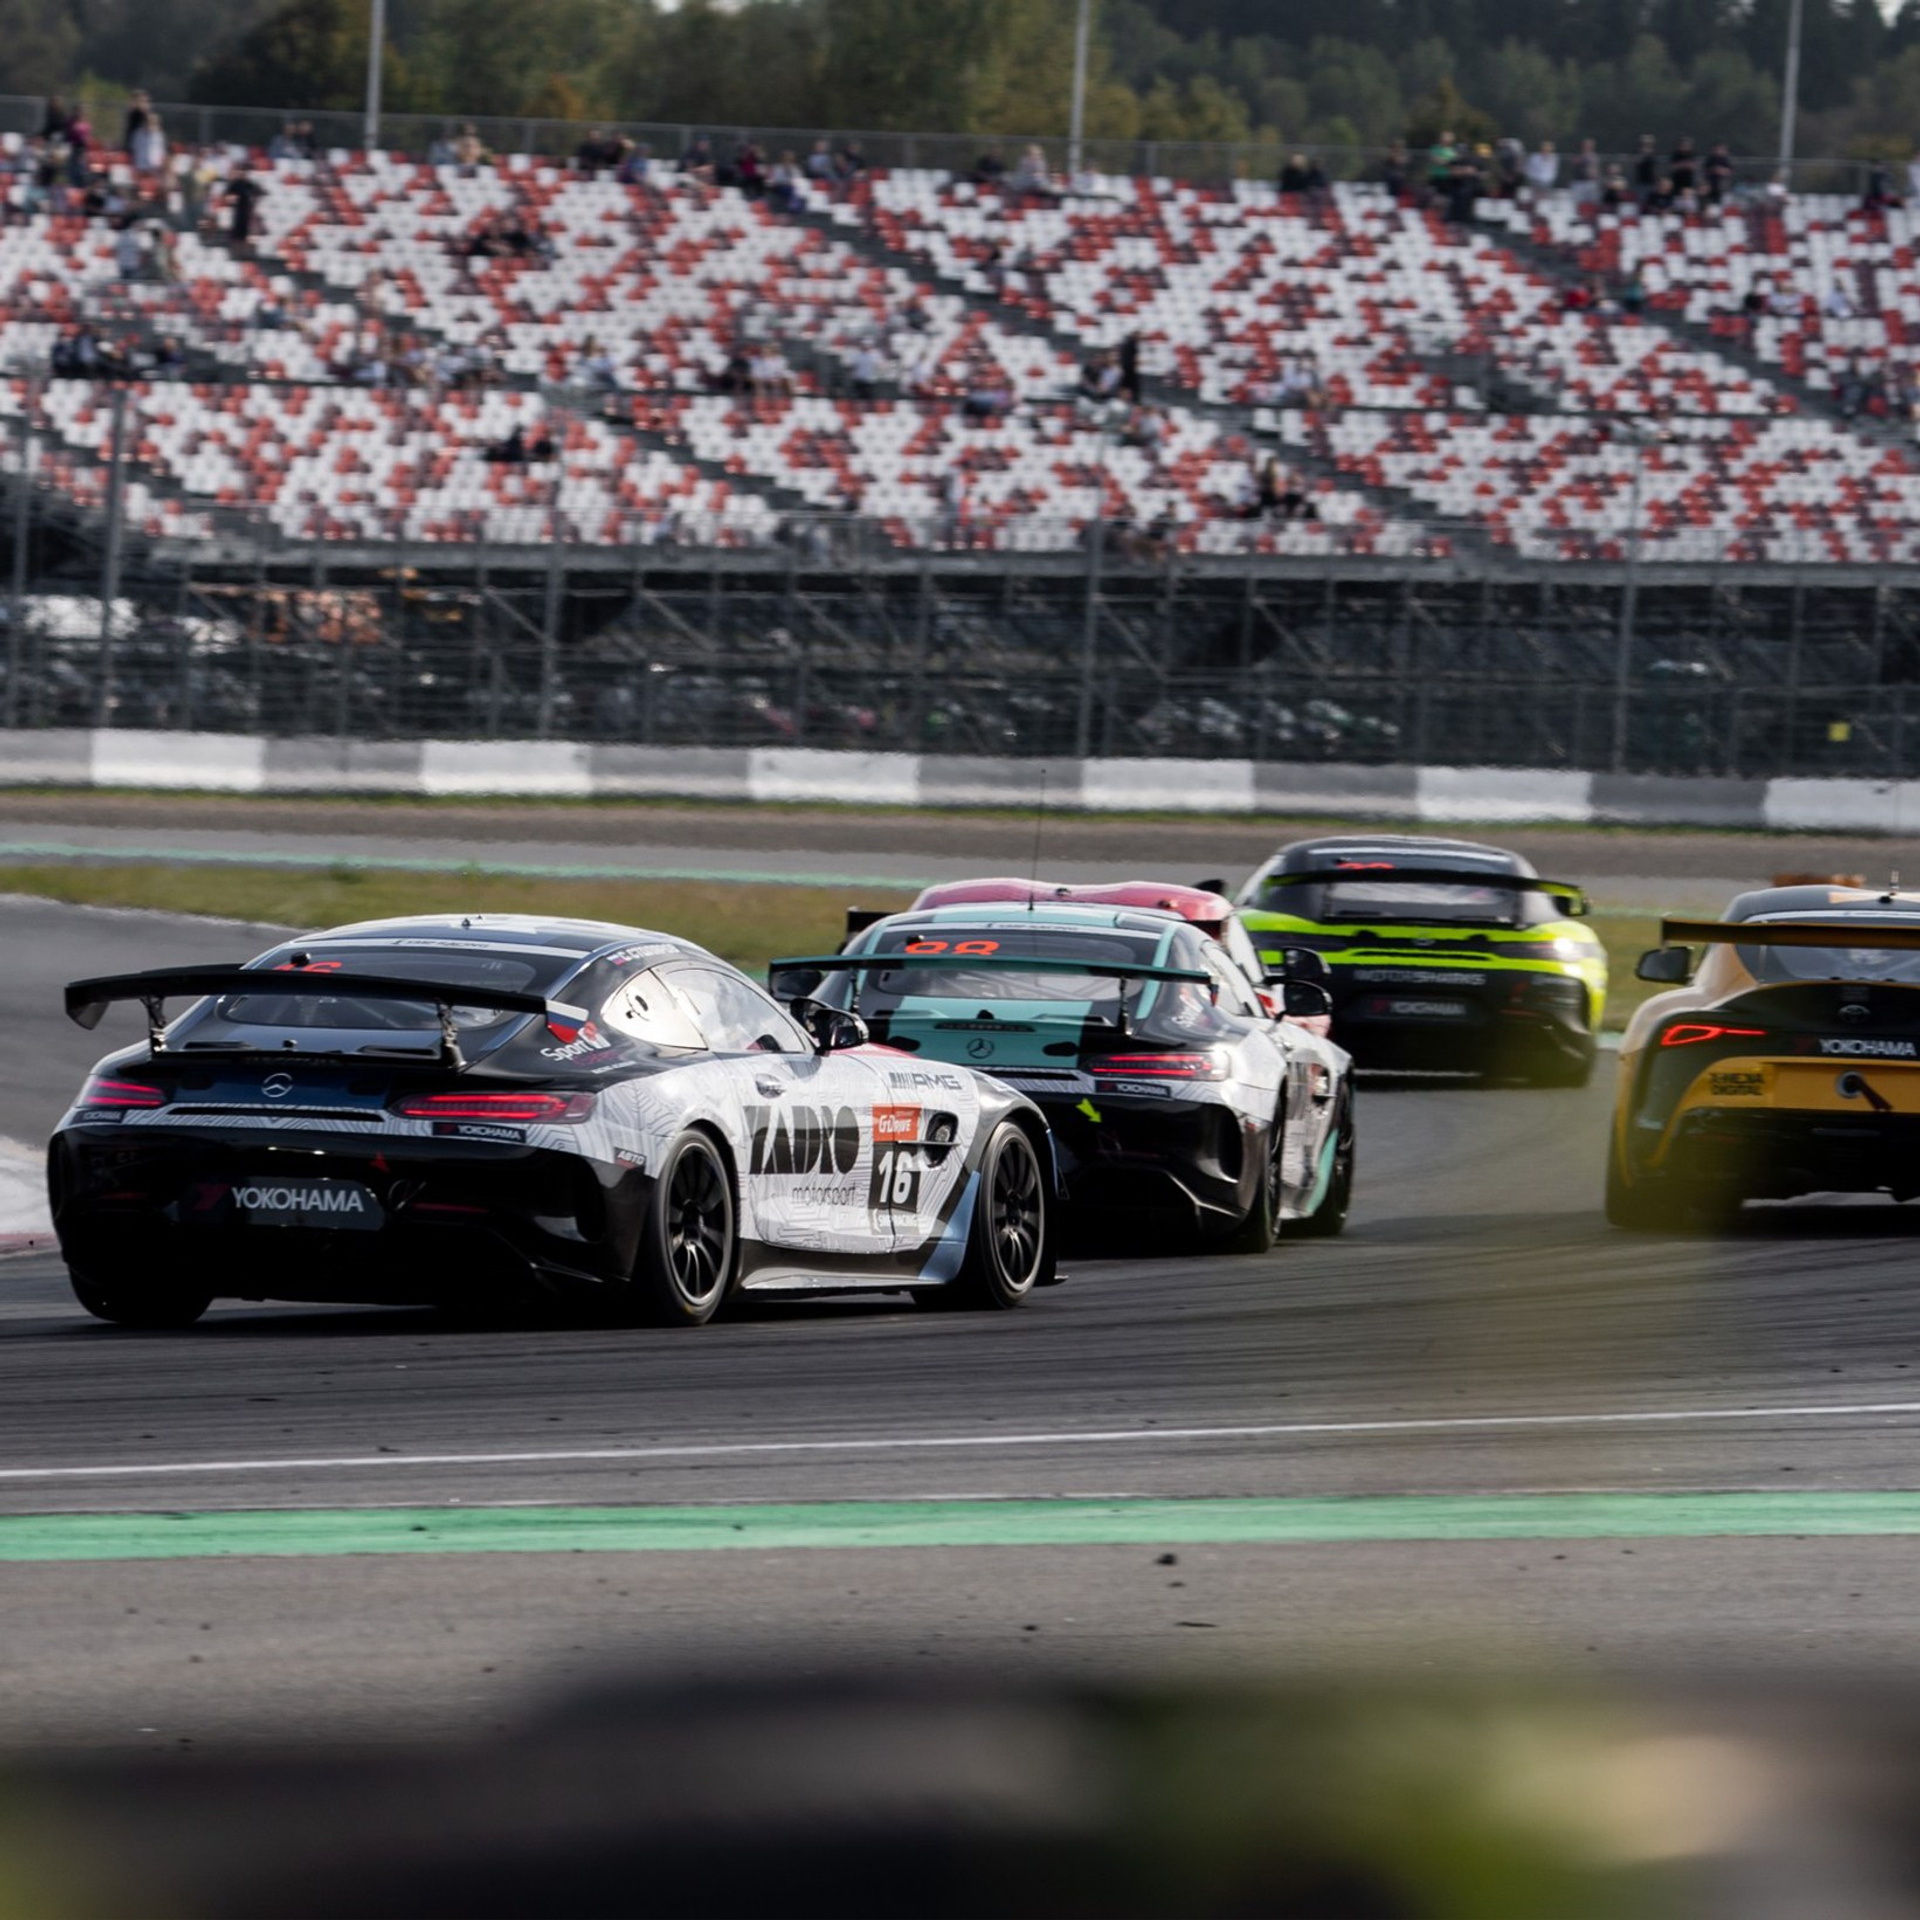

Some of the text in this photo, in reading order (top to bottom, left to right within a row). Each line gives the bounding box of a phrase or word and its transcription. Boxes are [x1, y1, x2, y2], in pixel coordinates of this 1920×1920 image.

[1819, 1039, 1916, 1056] YOKOHAMA
[458, 1125, 521, 1139] YOKOHAMA
[878, 1150, 913, 1204] 16
[231, 1187, 364, 1212] YOKOHAMA
